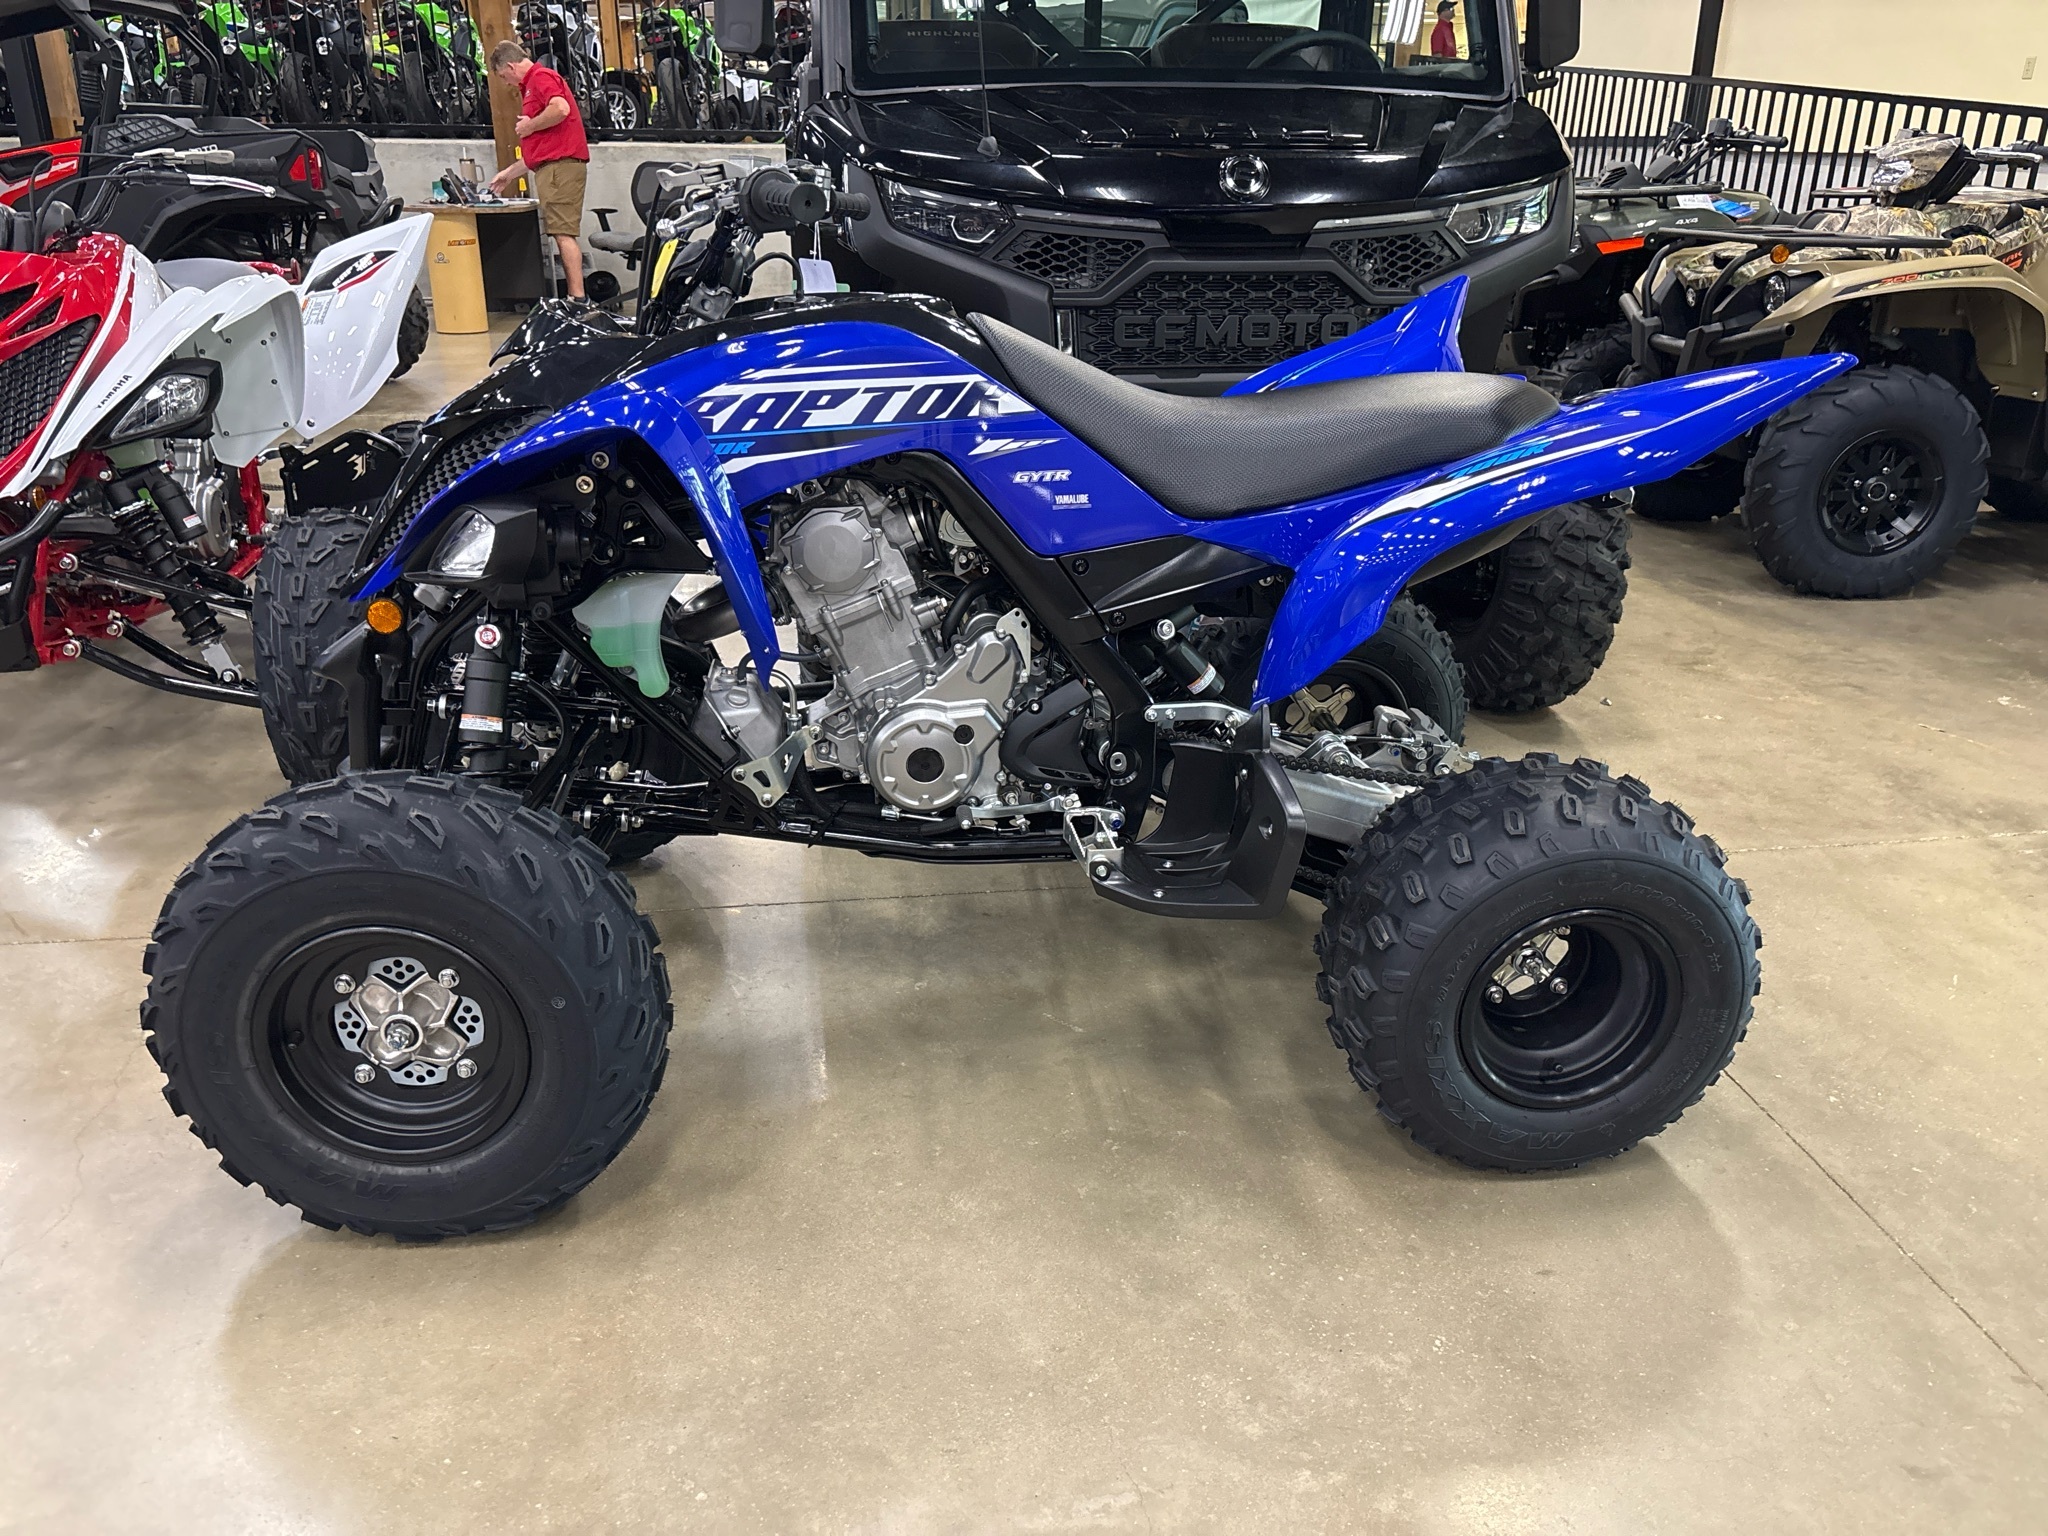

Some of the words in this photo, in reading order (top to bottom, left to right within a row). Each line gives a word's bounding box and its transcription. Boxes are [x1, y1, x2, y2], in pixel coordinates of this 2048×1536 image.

[1114, 314, 1358, 347] CFMOTO
[95, 374, 133, 409] YAMAHA
[1013, 470, 1072, 483] GYTR
[1055, 494, 1089, 504] YAMALUBE
[1424, 1018, 1575, 1150] MAXXIS
